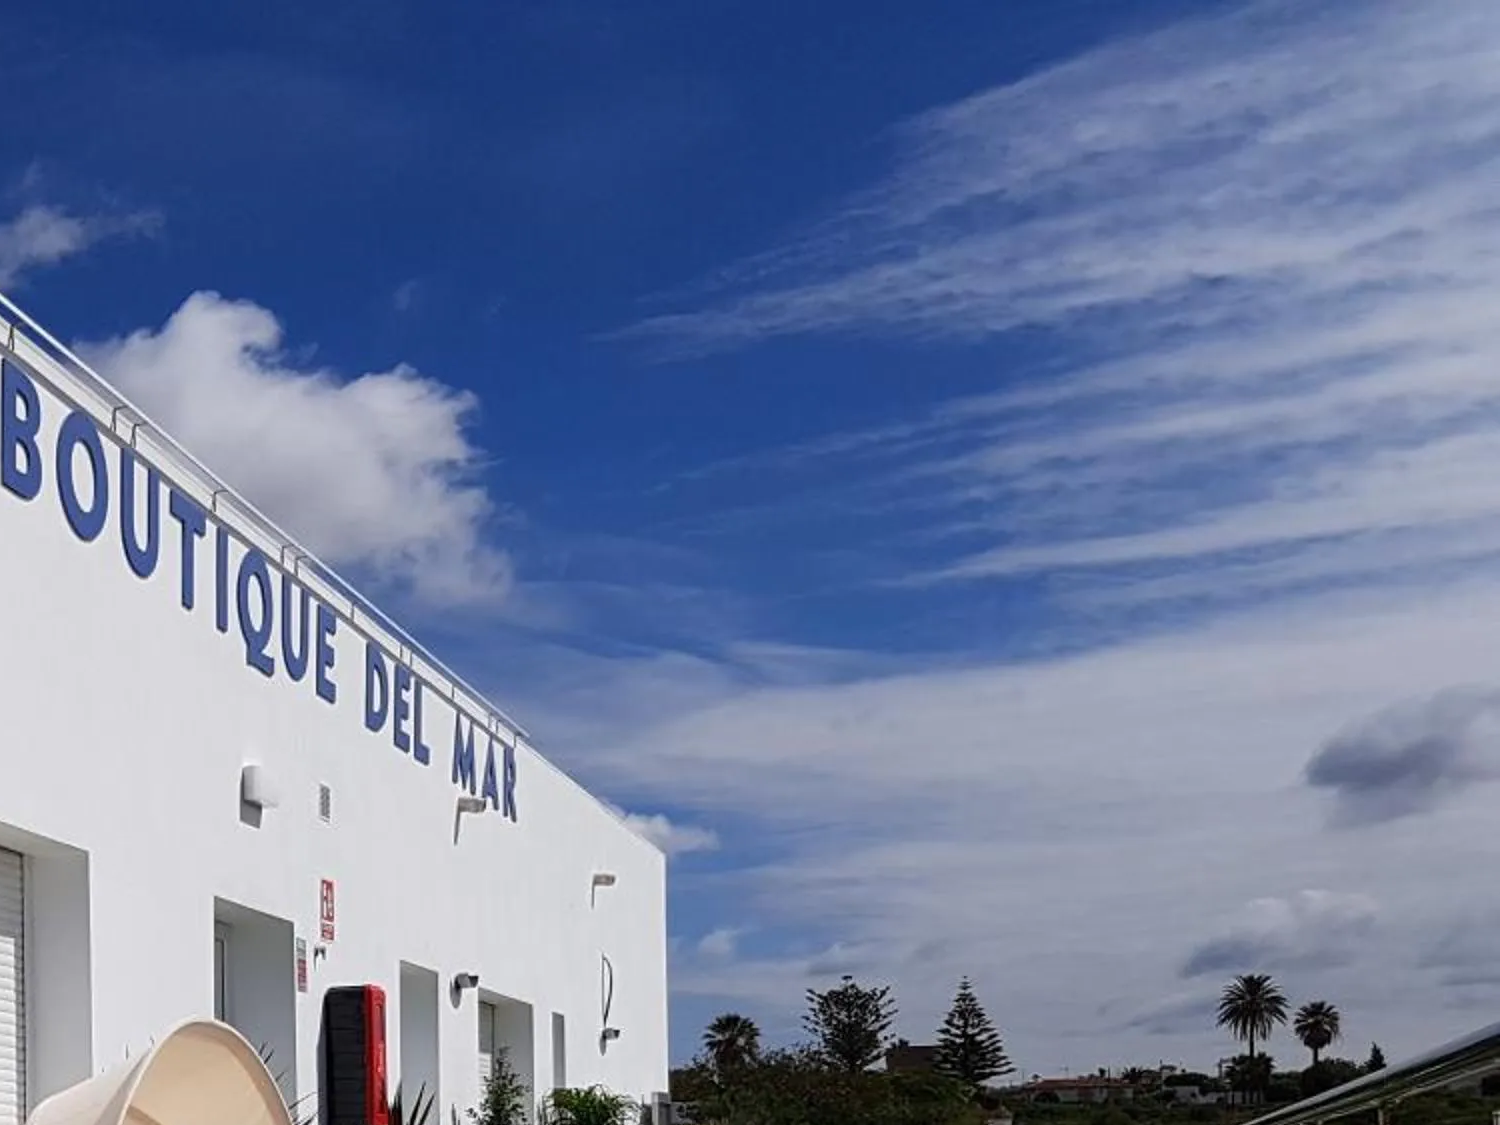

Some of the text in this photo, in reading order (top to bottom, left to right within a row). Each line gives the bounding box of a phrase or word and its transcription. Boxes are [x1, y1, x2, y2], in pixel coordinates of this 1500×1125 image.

[0, 357, 337, 705] BOUTIQUE
[364, 640, 429, 765] DEL
[452, 709, 517, 822] MAR
